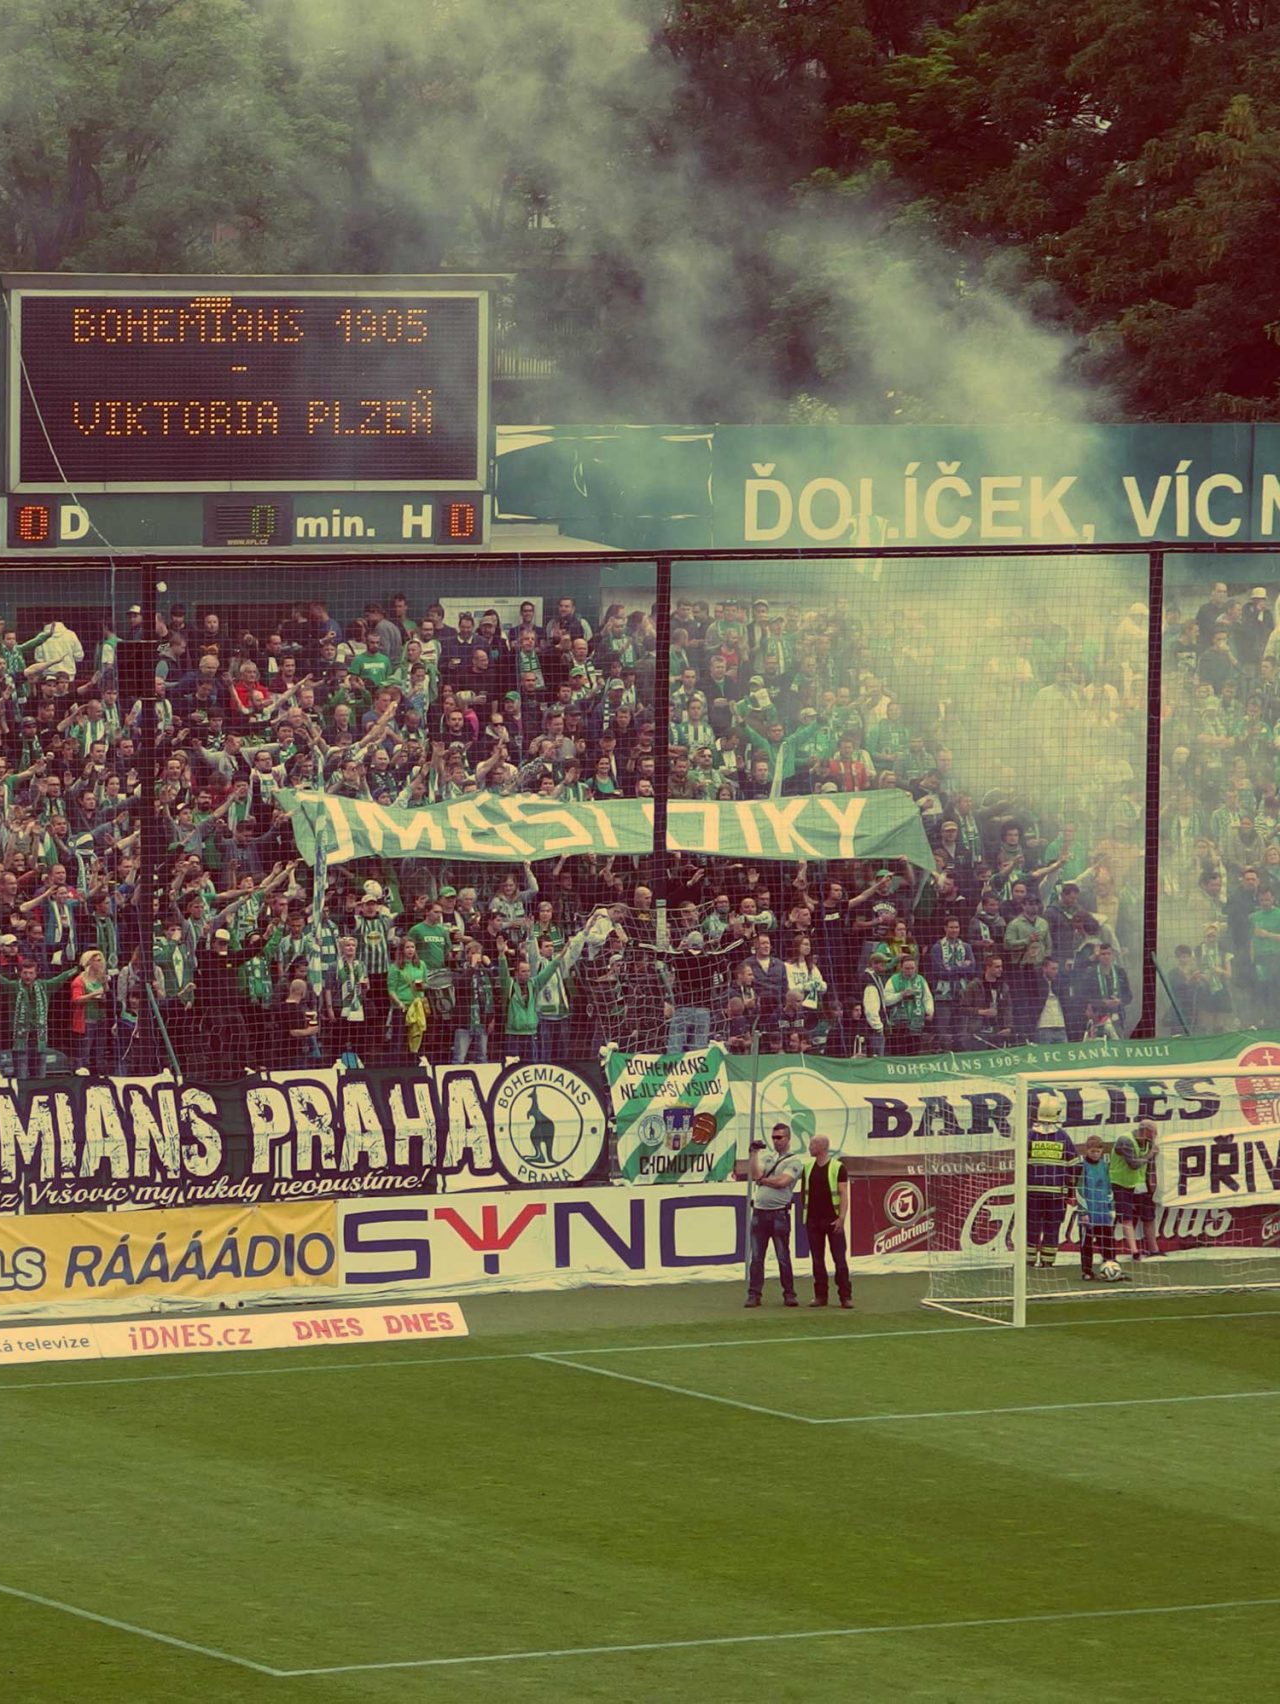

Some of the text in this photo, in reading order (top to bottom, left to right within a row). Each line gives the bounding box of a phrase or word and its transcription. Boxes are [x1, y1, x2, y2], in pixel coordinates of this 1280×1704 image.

[74, 309, 428, 342] BOHEMIANS 1905
[73, 389, 432, 435] VIKTORIA PLZEŇ
[1123, 459, 1243, 537] VÍC
[20, 505, 49, 540] 0
[60, 505, 90, 540] D
[296, 504, 433, 538] min. H
[450, 503, 474, 537] 0
[625, 1056, 710, 1077] BOHEMIANS
[886, 1056, 982, 1076] BOHEMIANS
[1026, 1052, 1038, 1063] &
[1043, 1051, 1062, 1063] FC
[1125, 1045, 1170, 1058] PAULI
[498, 1068, 592, 1110] BOHEMIANS
[248, 1076, 495, 1176] PRAHA
[517, 1164, 575, 1182] PRAHA
[639, 1152, 714, 1175] CHOMUTOV
[0, 1190, 19, 1208] z
[135, 1185, 178, 1205] my
[186, 1174, 263, 1203] nikdy
[271, 1168, 428, 1197] neopustíme!
[64, 1227, 335, 1291] RÁÁÁÁDIO
[128, 1323, 253, 1351] iDNES.cz
[292, 1316, 365, 1341] DNES
[382, 1311, 456, 1335] DNES
[17, 1335, 91, 1352] televize
